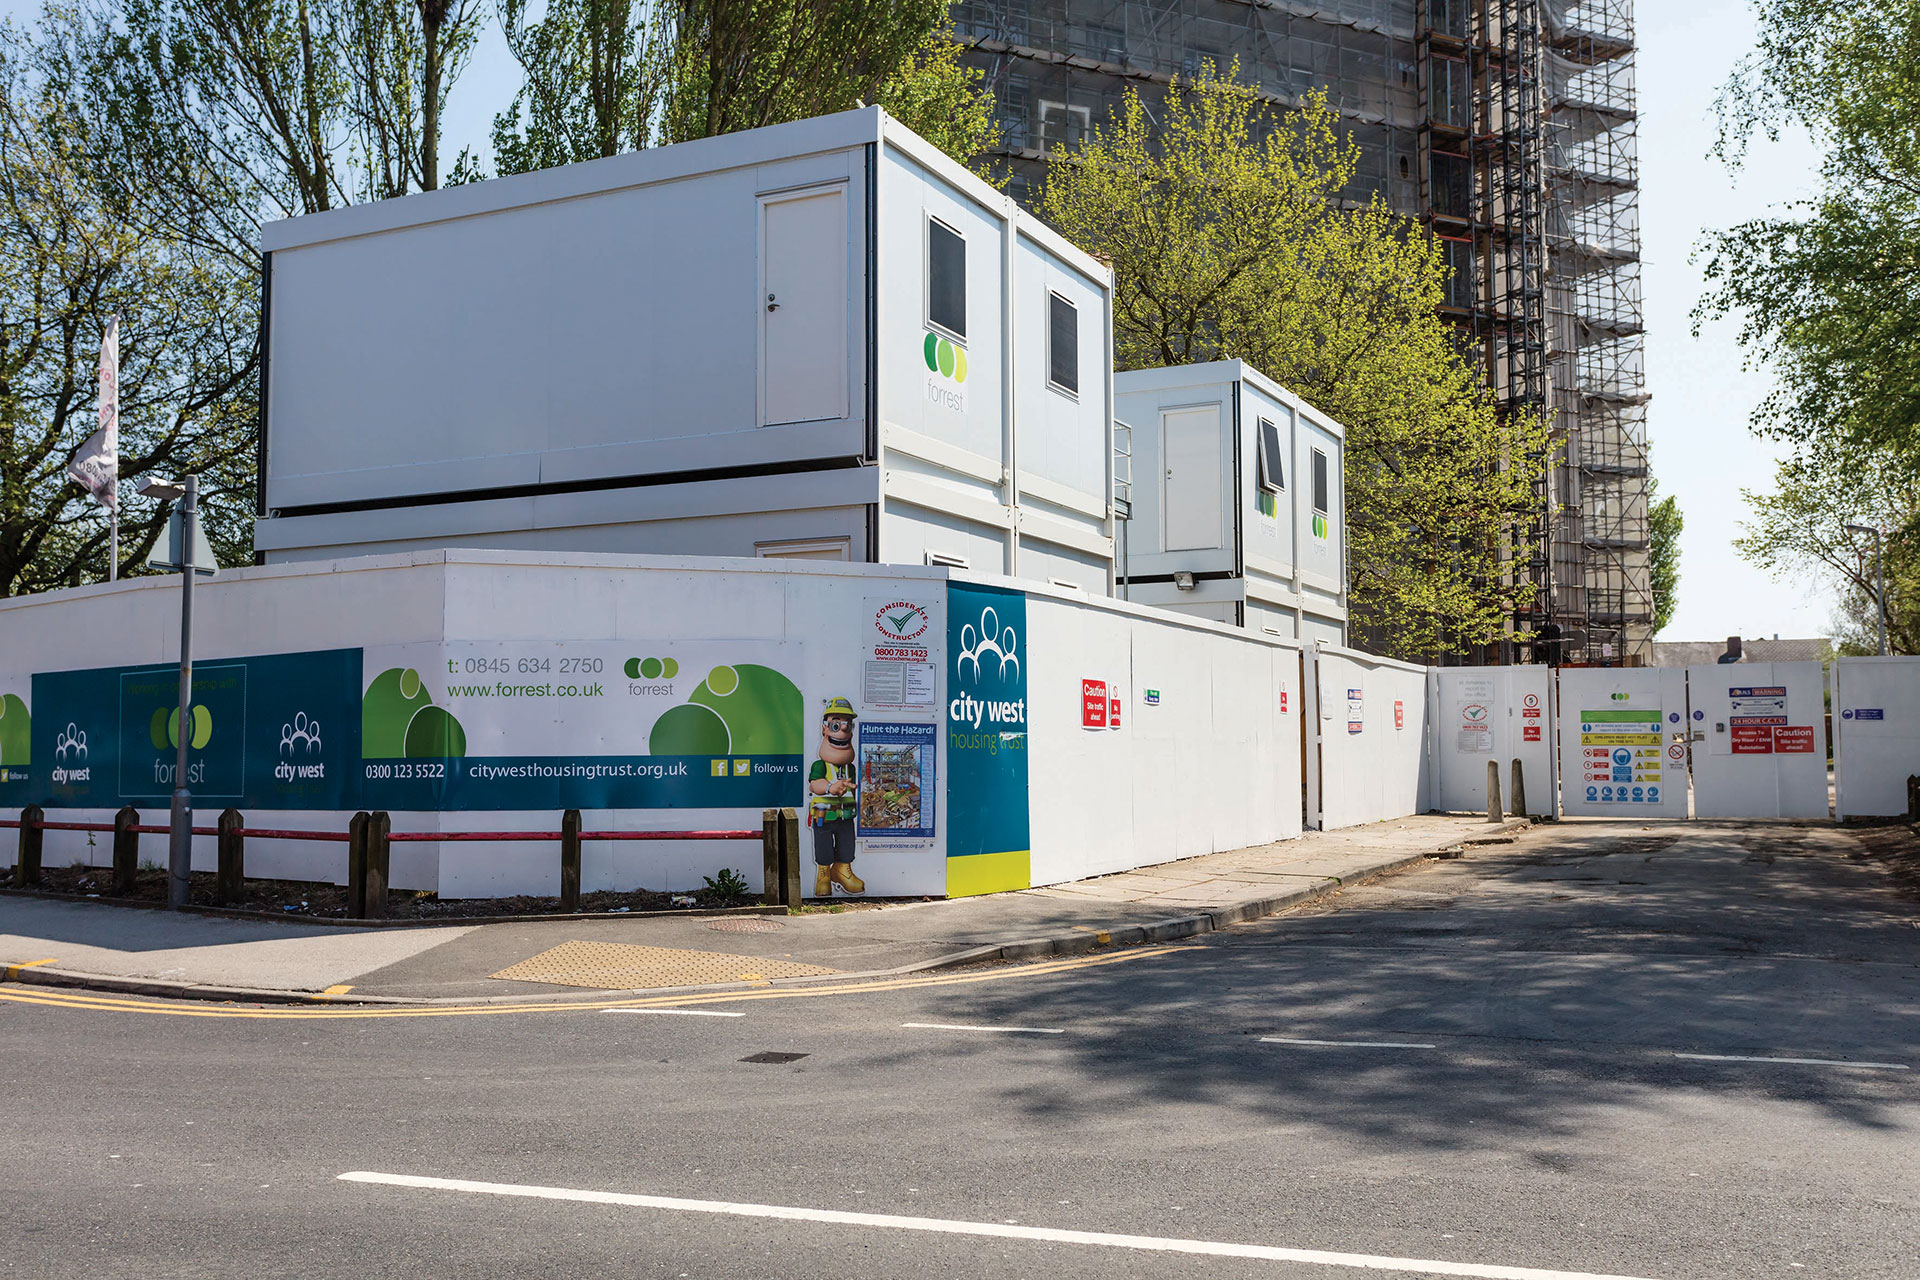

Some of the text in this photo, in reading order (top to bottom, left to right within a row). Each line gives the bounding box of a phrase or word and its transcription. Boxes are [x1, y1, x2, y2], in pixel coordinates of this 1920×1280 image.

[928, 378, 963, 413] forrest
[875, 601, 929, 622] CONSIDERATE
[874, 621, 929, 641] CONSTRUCTORS
[874, 648, 928, 658] 0800 783 1423
[448, 657, 603, 674] t: 0845 634 2750
[447, 682, 603, 697] www.forrest.co.uk
[629, 682, 674, 696] forrest
[1084, 684, 1105, 697] Caution
[950, 690, 1024, 730] city west
[861, 724, 883, 734] Hunt
[885, 725, 899, 734] the
[1776, 729, 1812, 737] Caution
[950, 726, 997, 755] housing
[52, 766, 91, 785] city west
[274, 761, 325, 782] city west
[365, 763, 444, 779] 0300 123 5522
[469, 761, 688, 781] citywesthousingtrust.org.uk
[754, 762, 785, 774] follow
[787, 764, 799, 774] us
